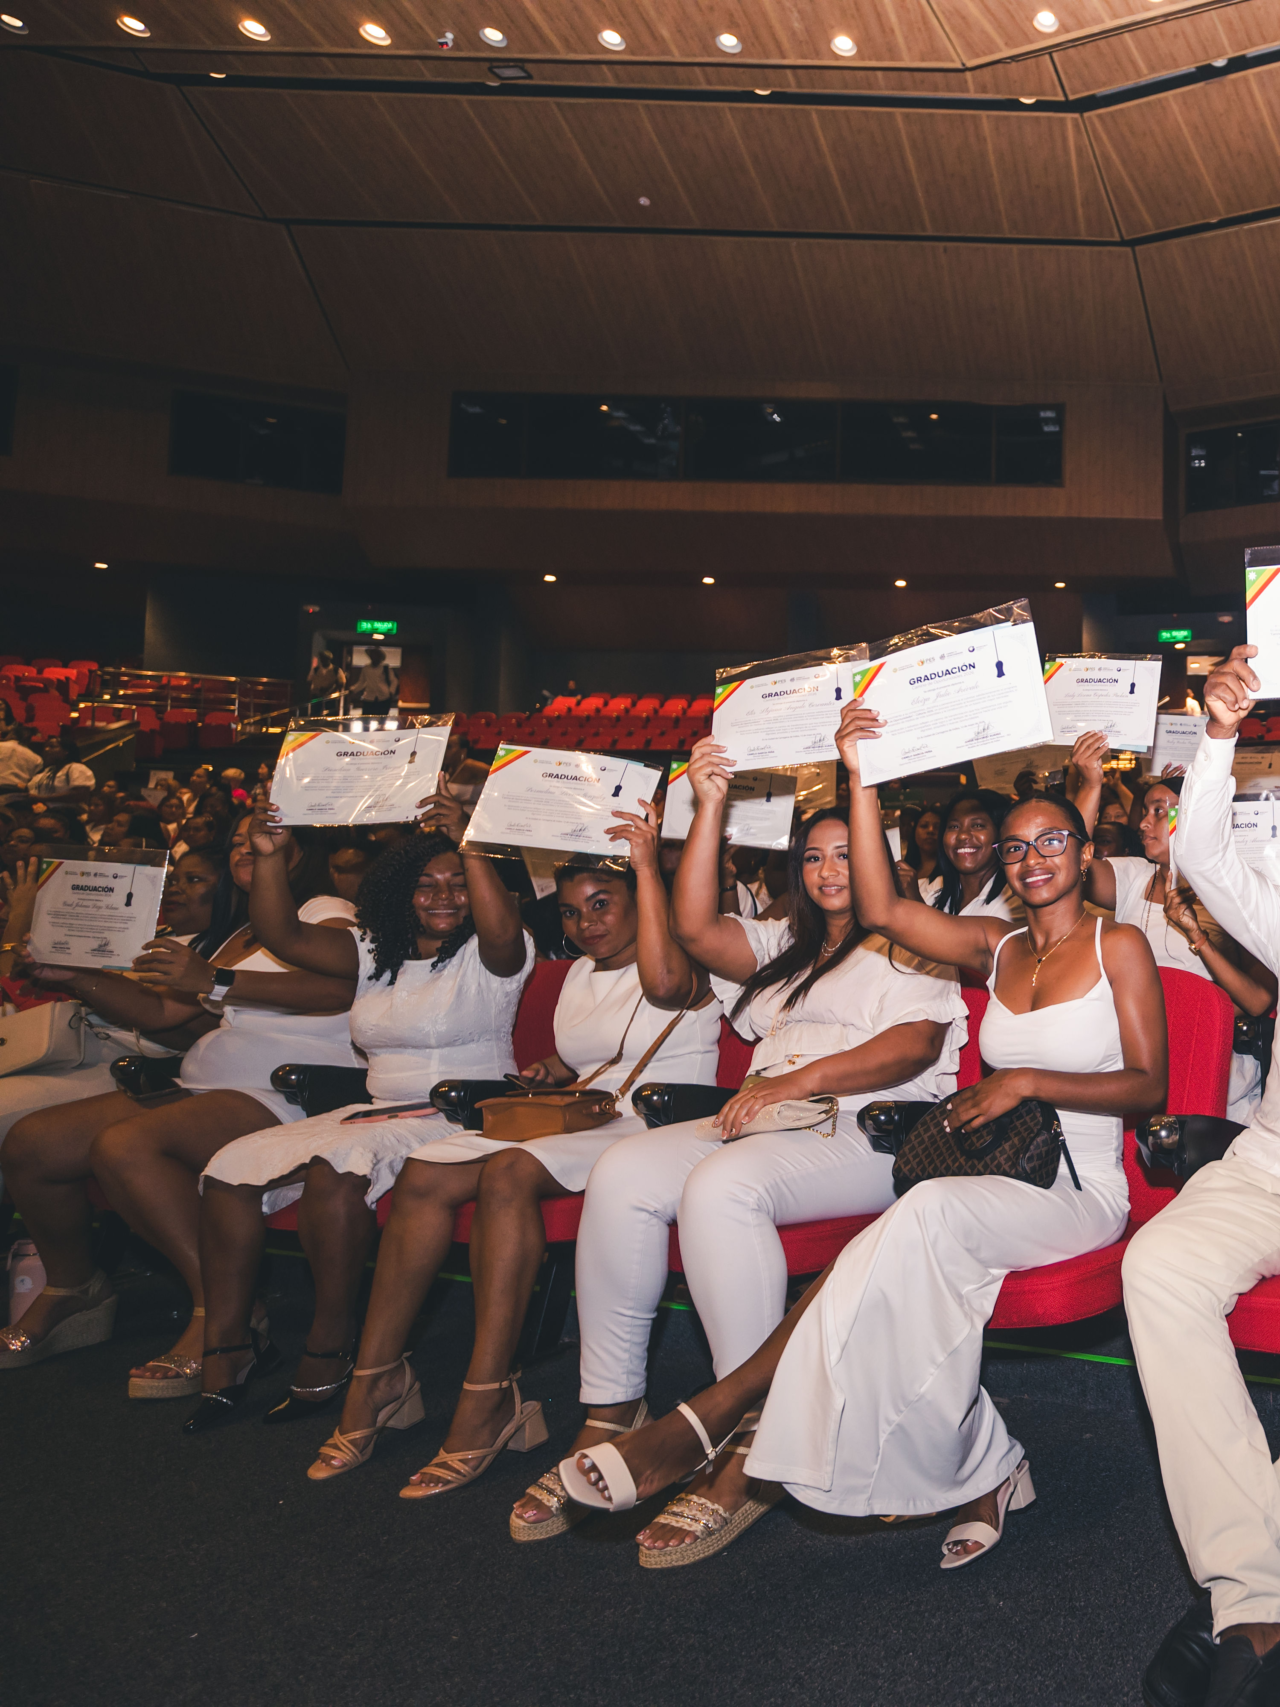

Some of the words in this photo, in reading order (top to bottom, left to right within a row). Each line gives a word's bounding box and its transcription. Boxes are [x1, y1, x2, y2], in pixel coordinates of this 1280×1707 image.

[909, 662, 976, 685] GRADUACIÓN
[761, 686, 819, 699] GRADUACIÓN
[542, 772, 600, 783] GRADUACIÓN
[728, 783, 755, 791] UACIÓN
[71, 884, 114, 893] GRADUACIÓN
